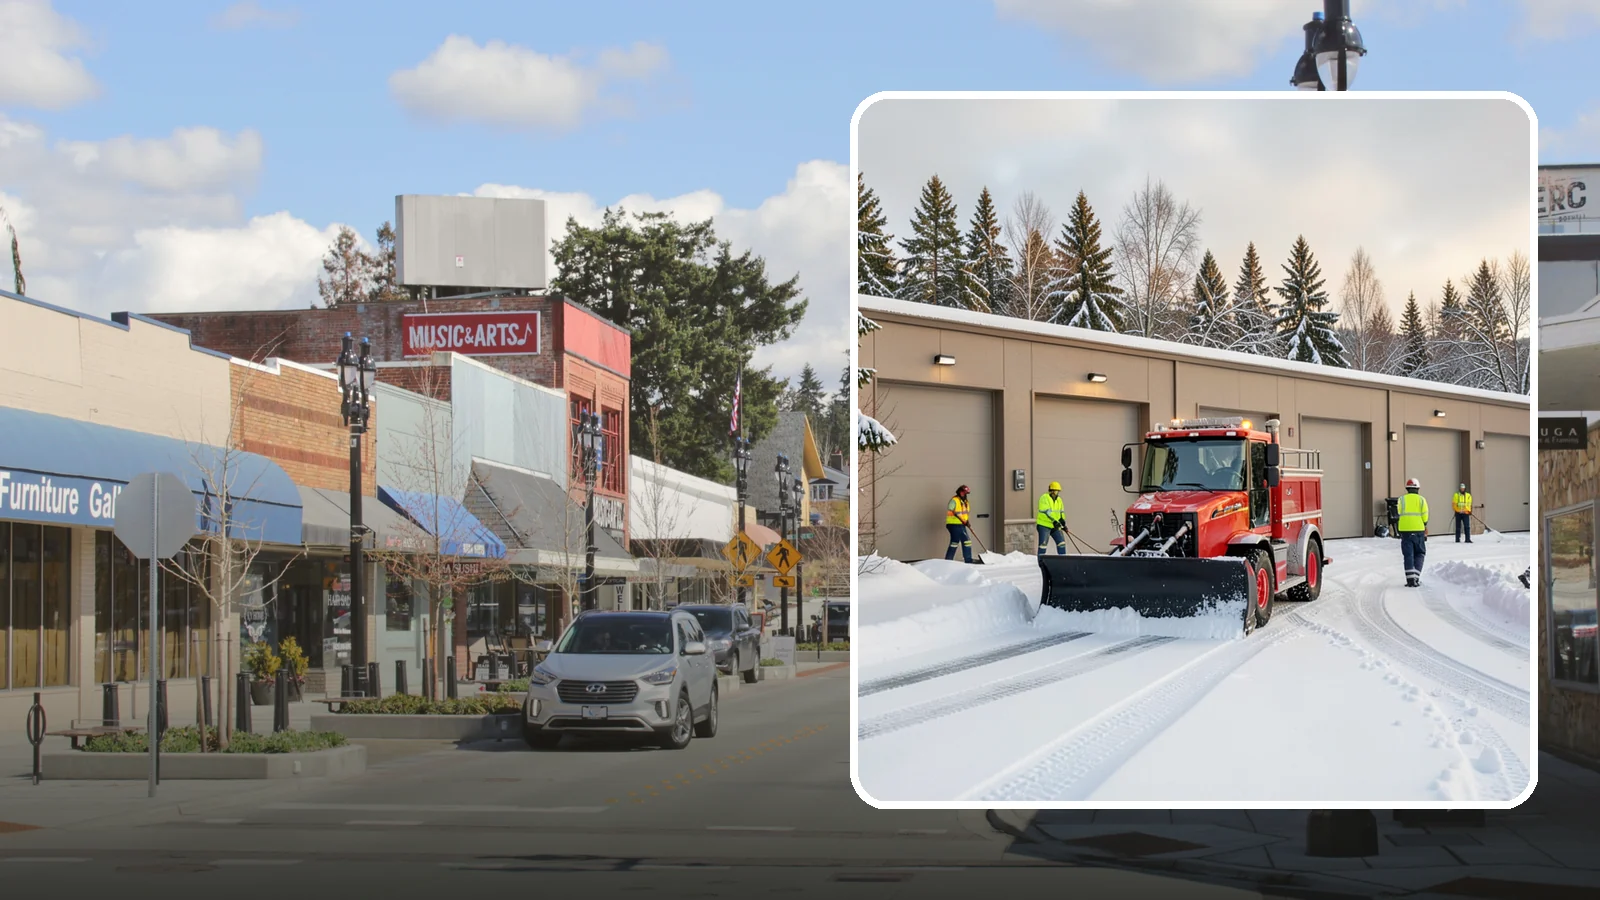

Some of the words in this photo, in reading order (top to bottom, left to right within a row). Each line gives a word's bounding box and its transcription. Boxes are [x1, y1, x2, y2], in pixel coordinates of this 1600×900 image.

[0, 471, 79, 515] Furniture
[89, 482, 122, 519] Gal
[453, 563, 479, 574] SUSHI
